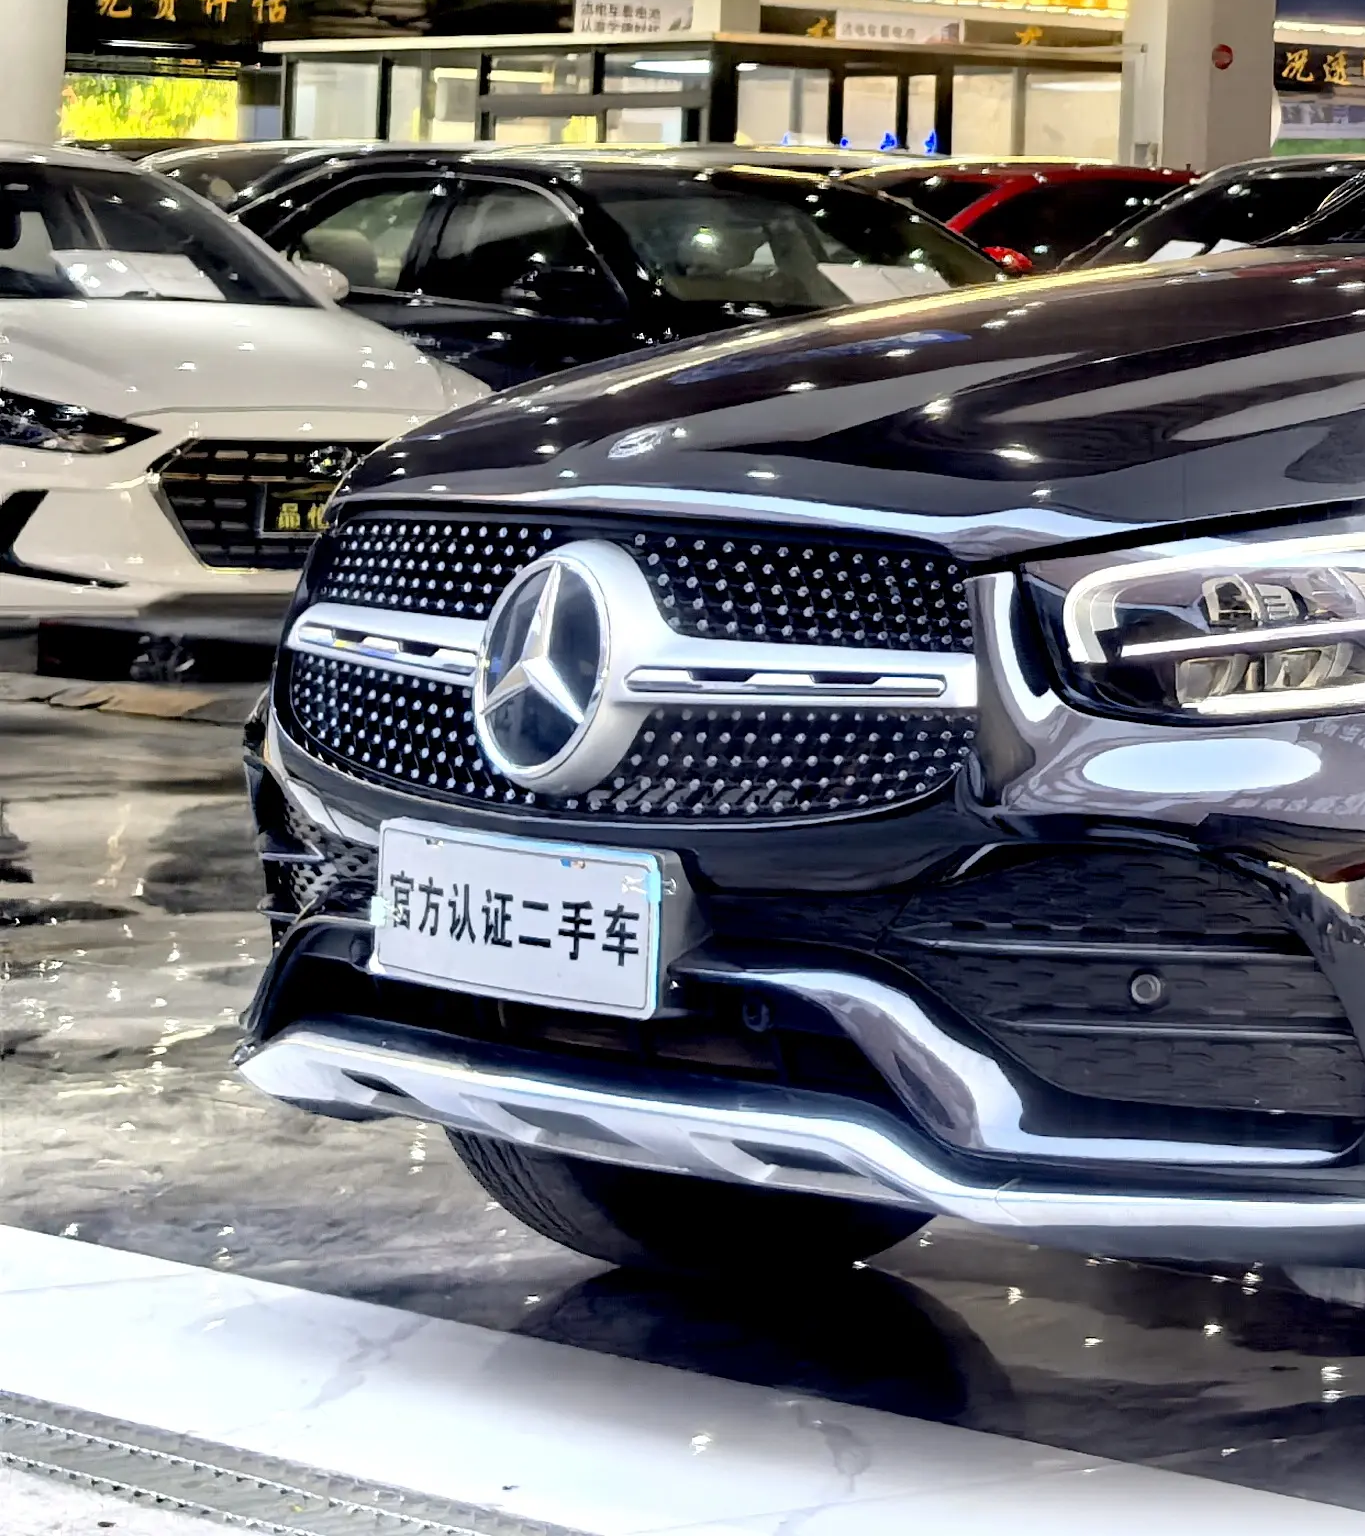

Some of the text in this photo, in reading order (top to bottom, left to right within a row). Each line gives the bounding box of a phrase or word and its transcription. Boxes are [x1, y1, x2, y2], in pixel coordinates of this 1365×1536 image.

[389, 870, 641, 967] 官方认证二手车
